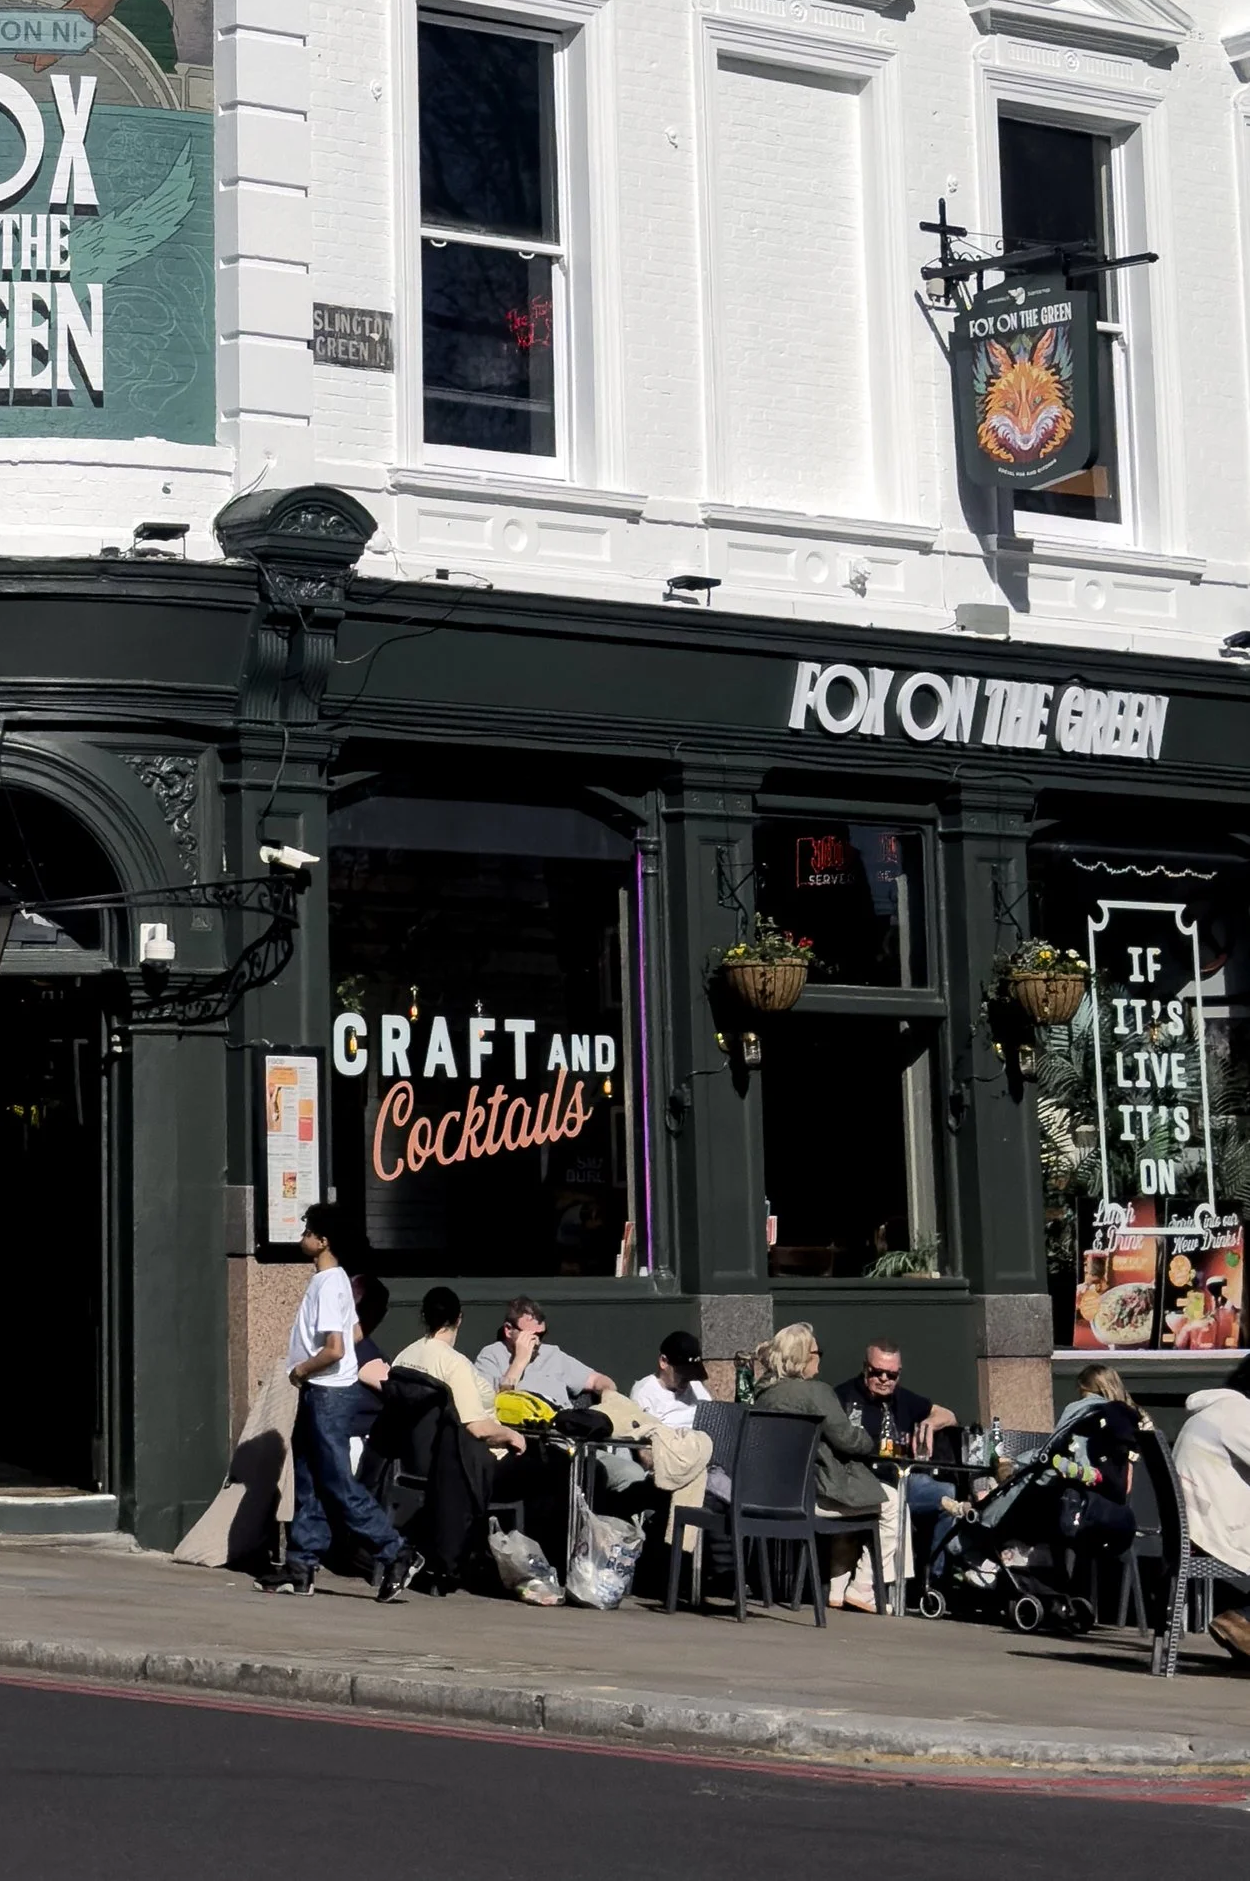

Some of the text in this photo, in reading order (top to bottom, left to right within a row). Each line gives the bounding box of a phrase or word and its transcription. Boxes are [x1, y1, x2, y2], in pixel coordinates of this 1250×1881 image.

[313, 310, 393, 338] SLINGTON
[969, 302, 1072, 338] FOX ON THE GREEN
[789, 661, 1169, 760] FOX ON THE GREEN
[1127, 946, 1162, 983] IF
[1112, 998, 1184, 1036] IT'S
[333, 1012, 615, 1080] CRAFT AND
[1115, 1051, 1187, 1089] LIVE
[373, 1067, 594, 1181] Cocktails
[1118, 1105, 1191, 1142] IT'S
[1140, 1158, 1176, 1195] ON
[1171, 1225, 1243, 1255] New Drinks!
